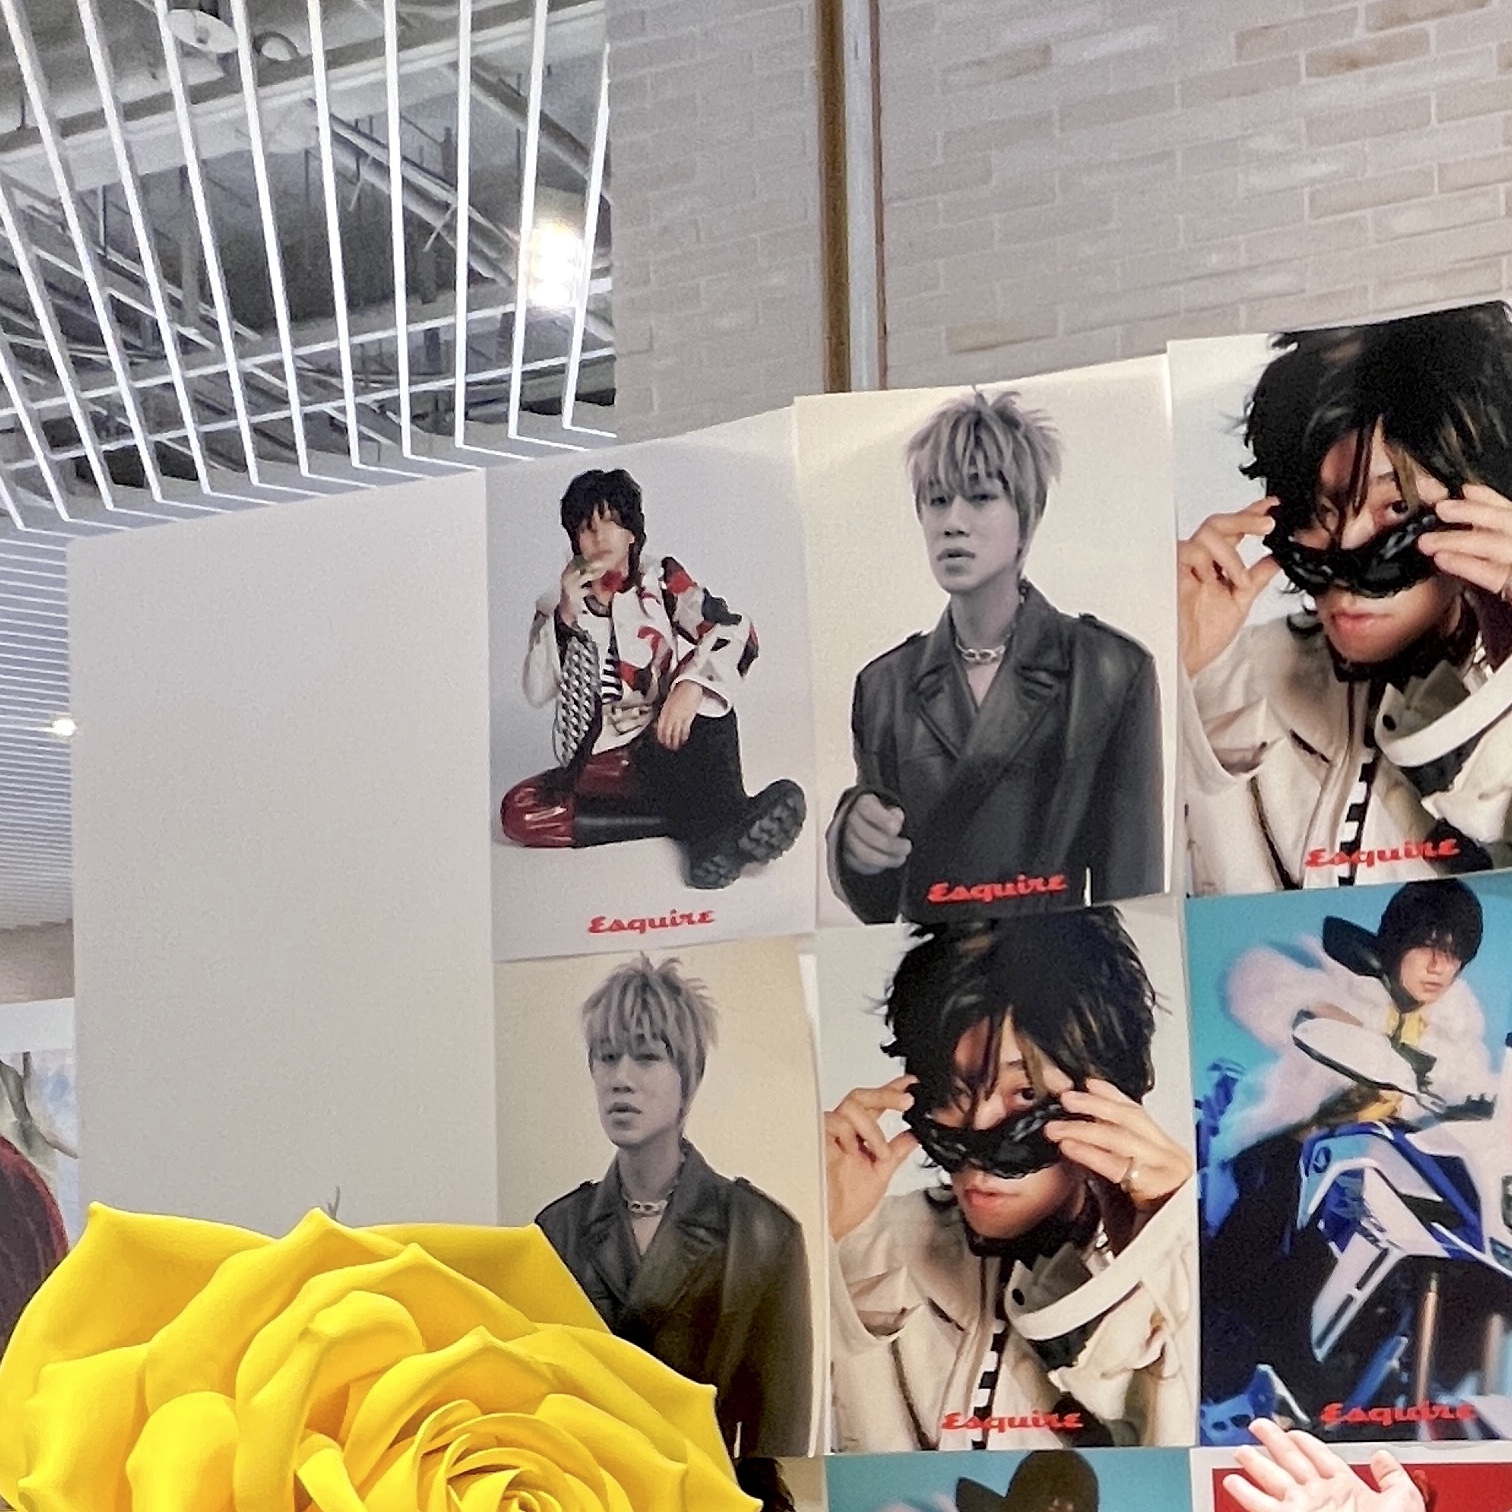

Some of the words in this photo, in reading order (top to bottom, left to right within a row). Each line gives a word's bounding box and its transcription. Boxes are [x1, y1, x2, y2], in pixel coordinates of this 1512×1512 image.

[1306, 838, 1461, 867] Esquire
[927, 874, 1068, 904] Esquire
[588, 909, 715, 934] Esquire
[942, 1409, 1083, 1436] Esquire
[1320, 1400, 1475, 1428] Esquire
